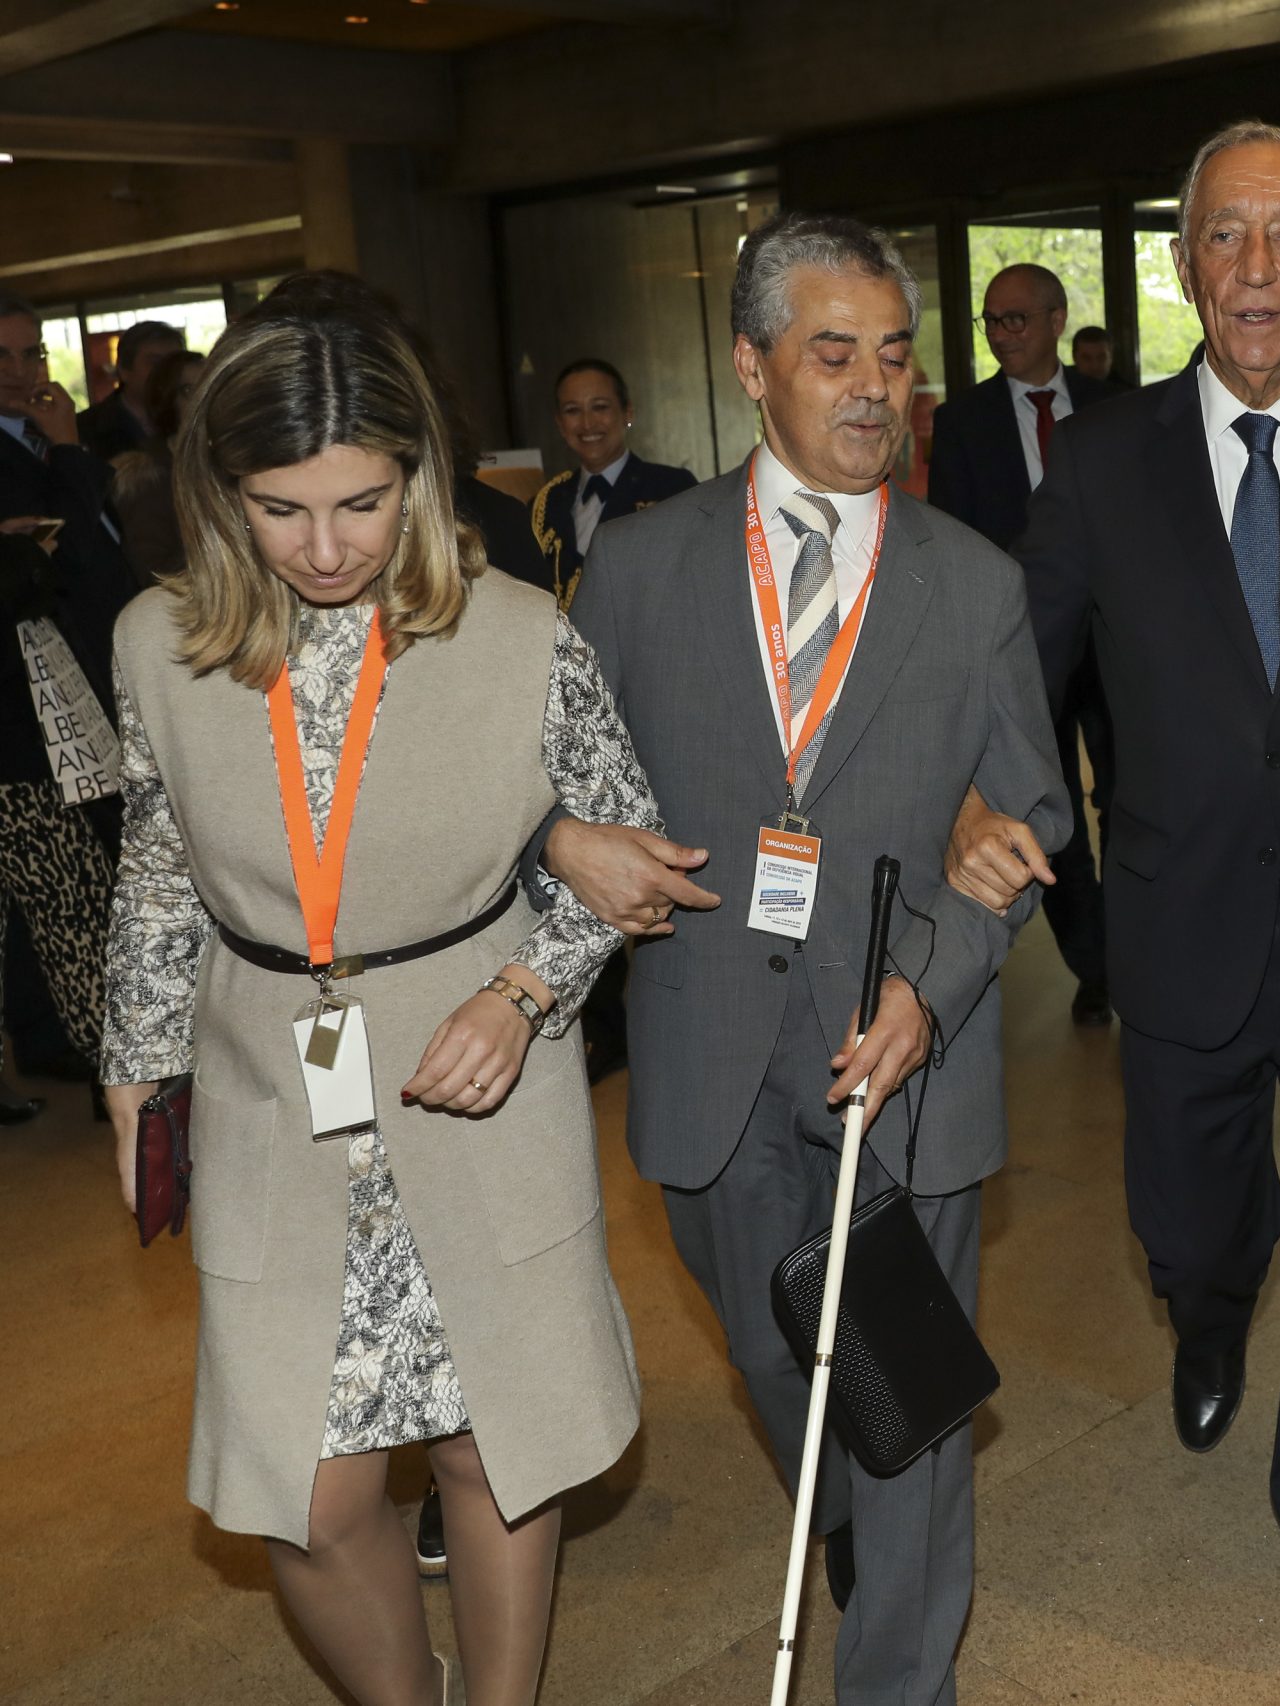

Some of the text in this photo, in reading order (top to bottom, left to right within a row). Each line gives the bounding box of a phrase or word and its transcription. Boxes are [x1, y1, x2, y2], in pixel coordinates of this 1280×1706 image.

[747, 512, 759, 530] 30
[750, 532, 773, 586] ACAPO
[770, 623, 790, 731] APO 30 anos
[57, 741, 101, 778] AN
[765, 839, 812, 854] ORGANIZAÇÃO
